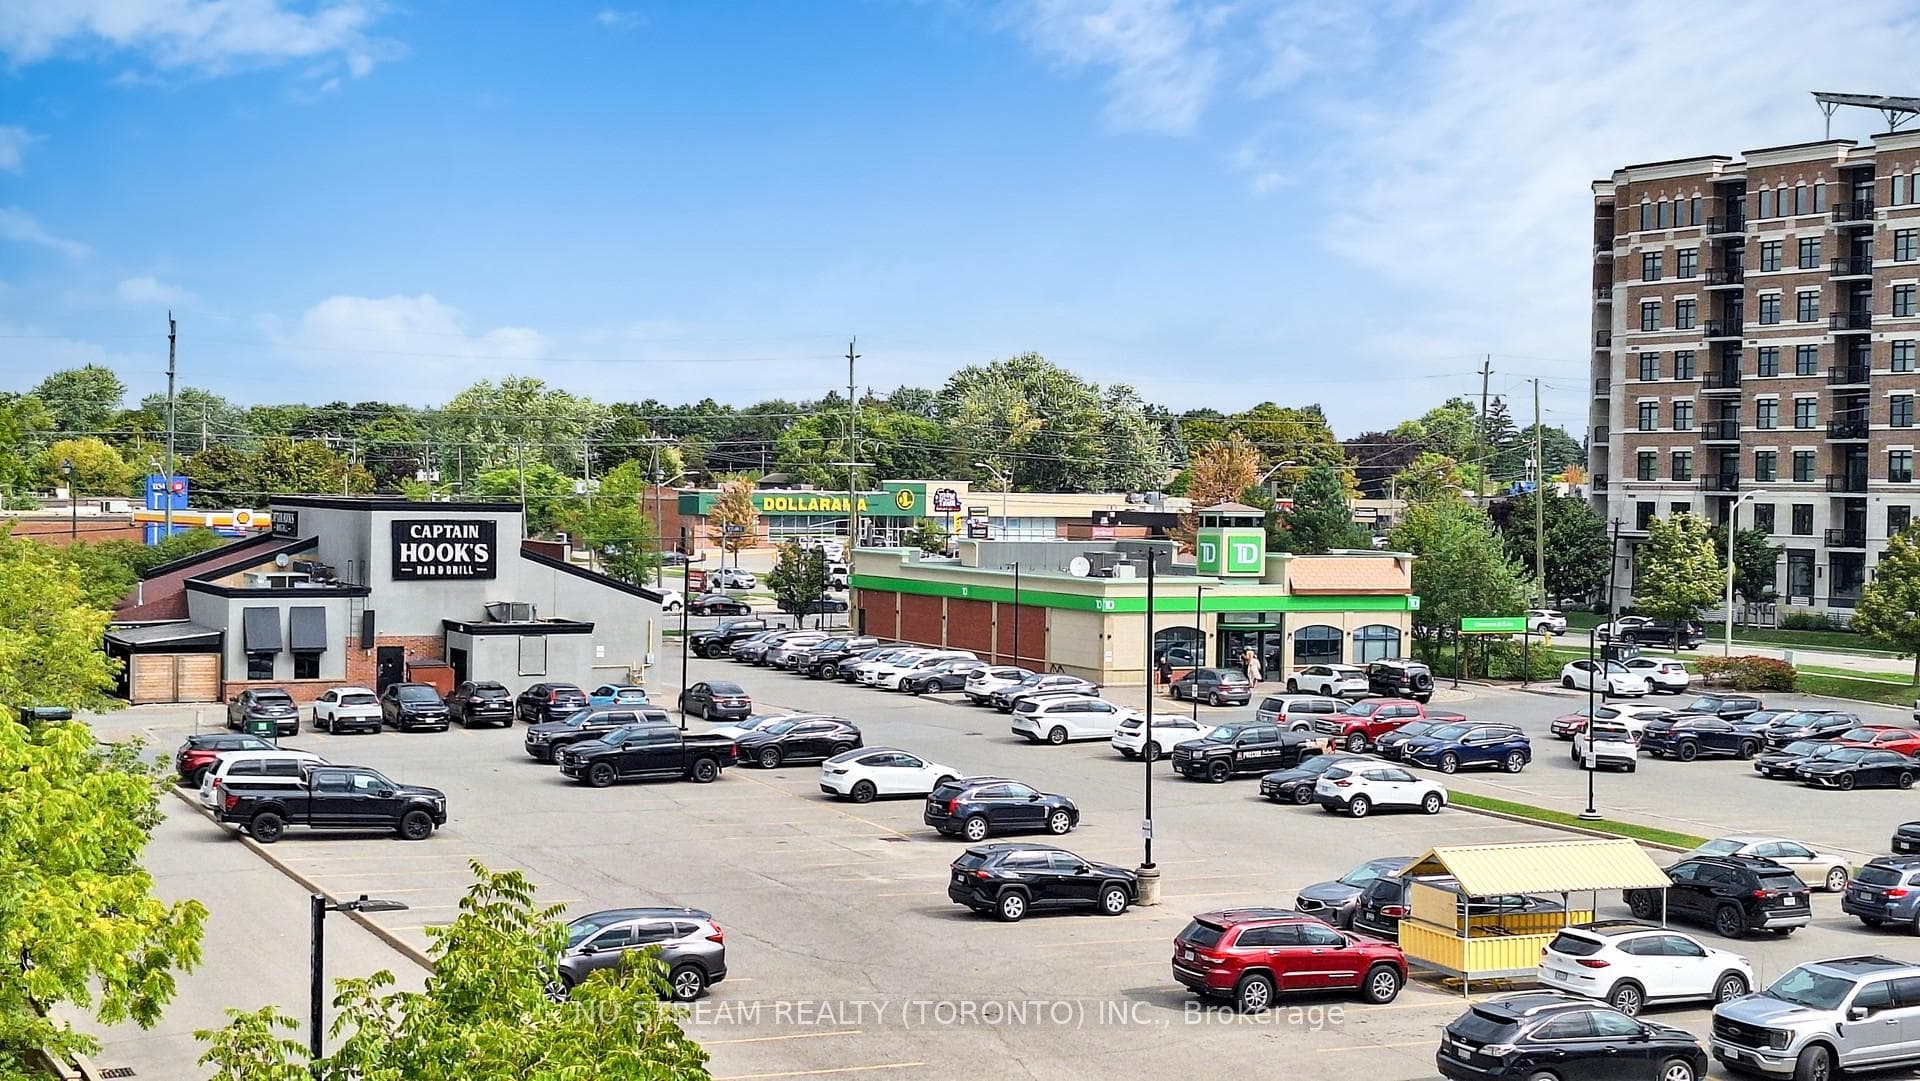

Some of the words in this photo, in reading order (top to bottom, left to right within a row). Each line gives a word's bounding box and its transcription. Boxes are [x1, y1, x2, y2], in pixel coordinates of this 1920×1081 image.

[410, 524, 479, 539] CAPTAIN
[400, 543, 489, 562] HOOK'S
[1200, 542, 1216, 563] TD
[1232, 543, 1259, 564] TD
[416, 565, 436, 575] BAR
[446, 565, 474, 575] GRILL
